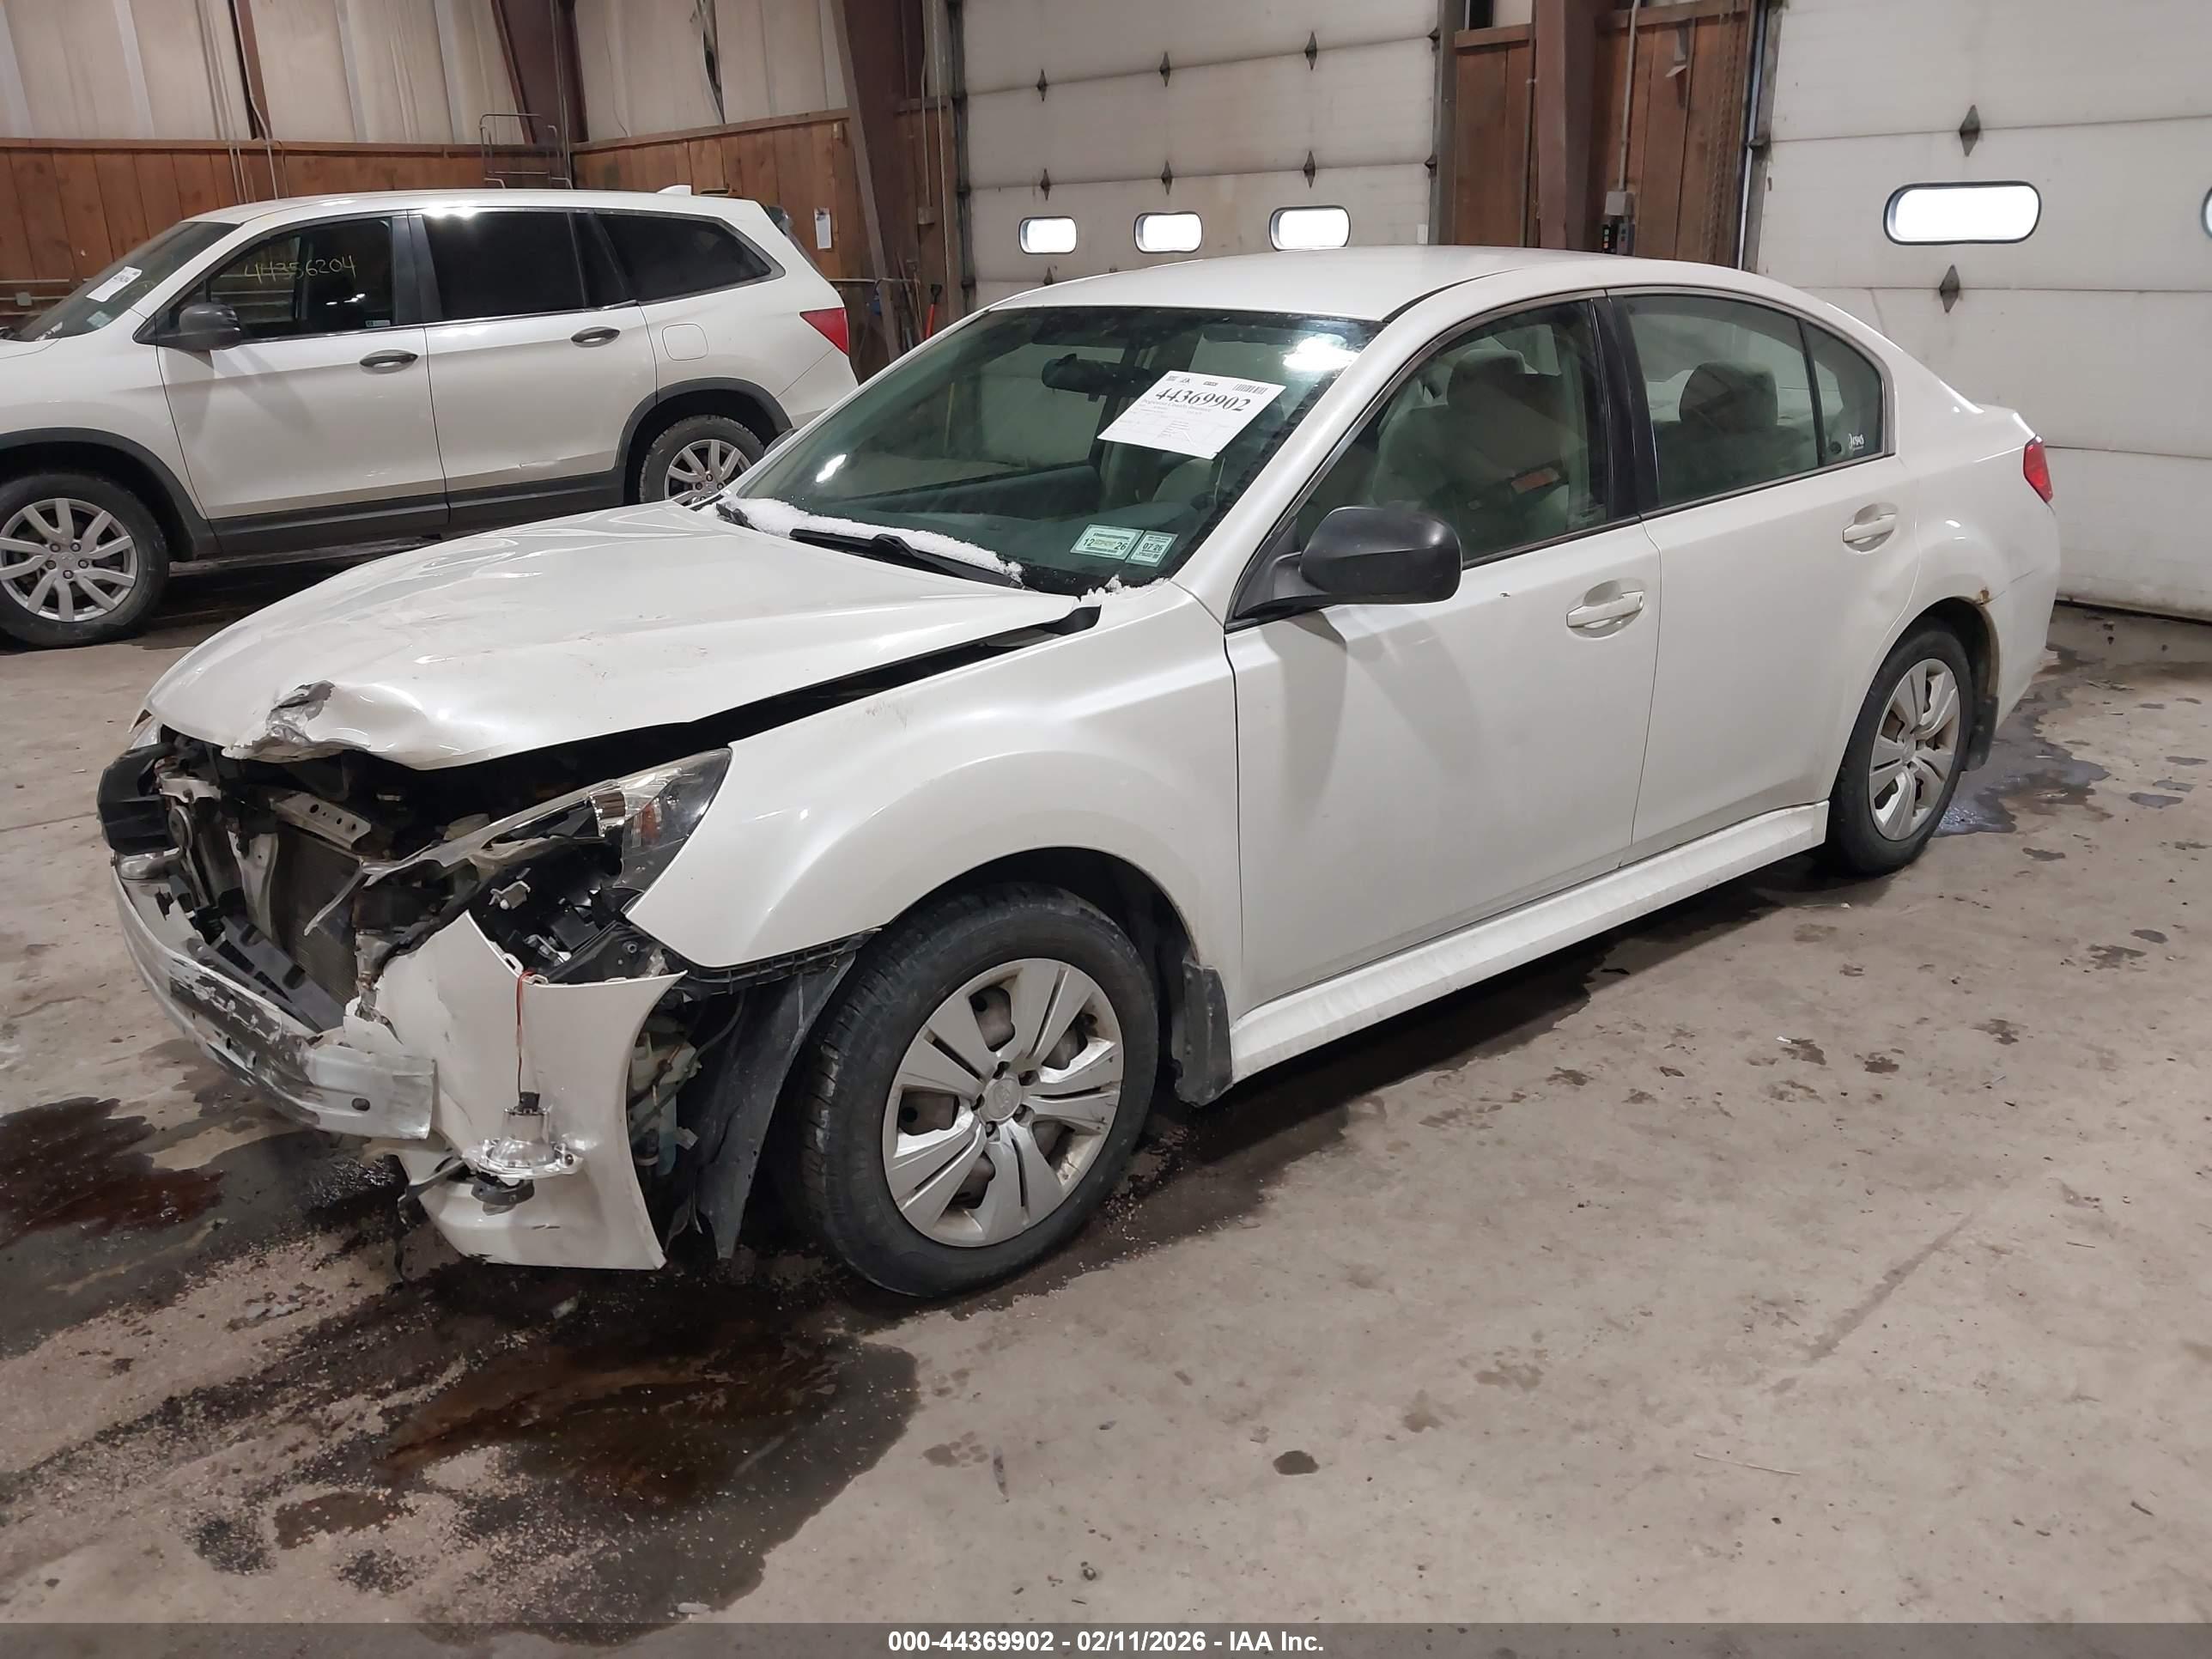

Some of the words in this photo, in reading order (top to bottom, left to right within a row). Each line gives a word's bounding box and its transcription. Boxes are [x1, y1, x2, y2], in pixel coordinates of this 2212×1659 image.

[1155, 387, 1251, 412] 44369902
[1083, 538, 1096, 547] 12
[1114, 542, 1128, 550] 26
